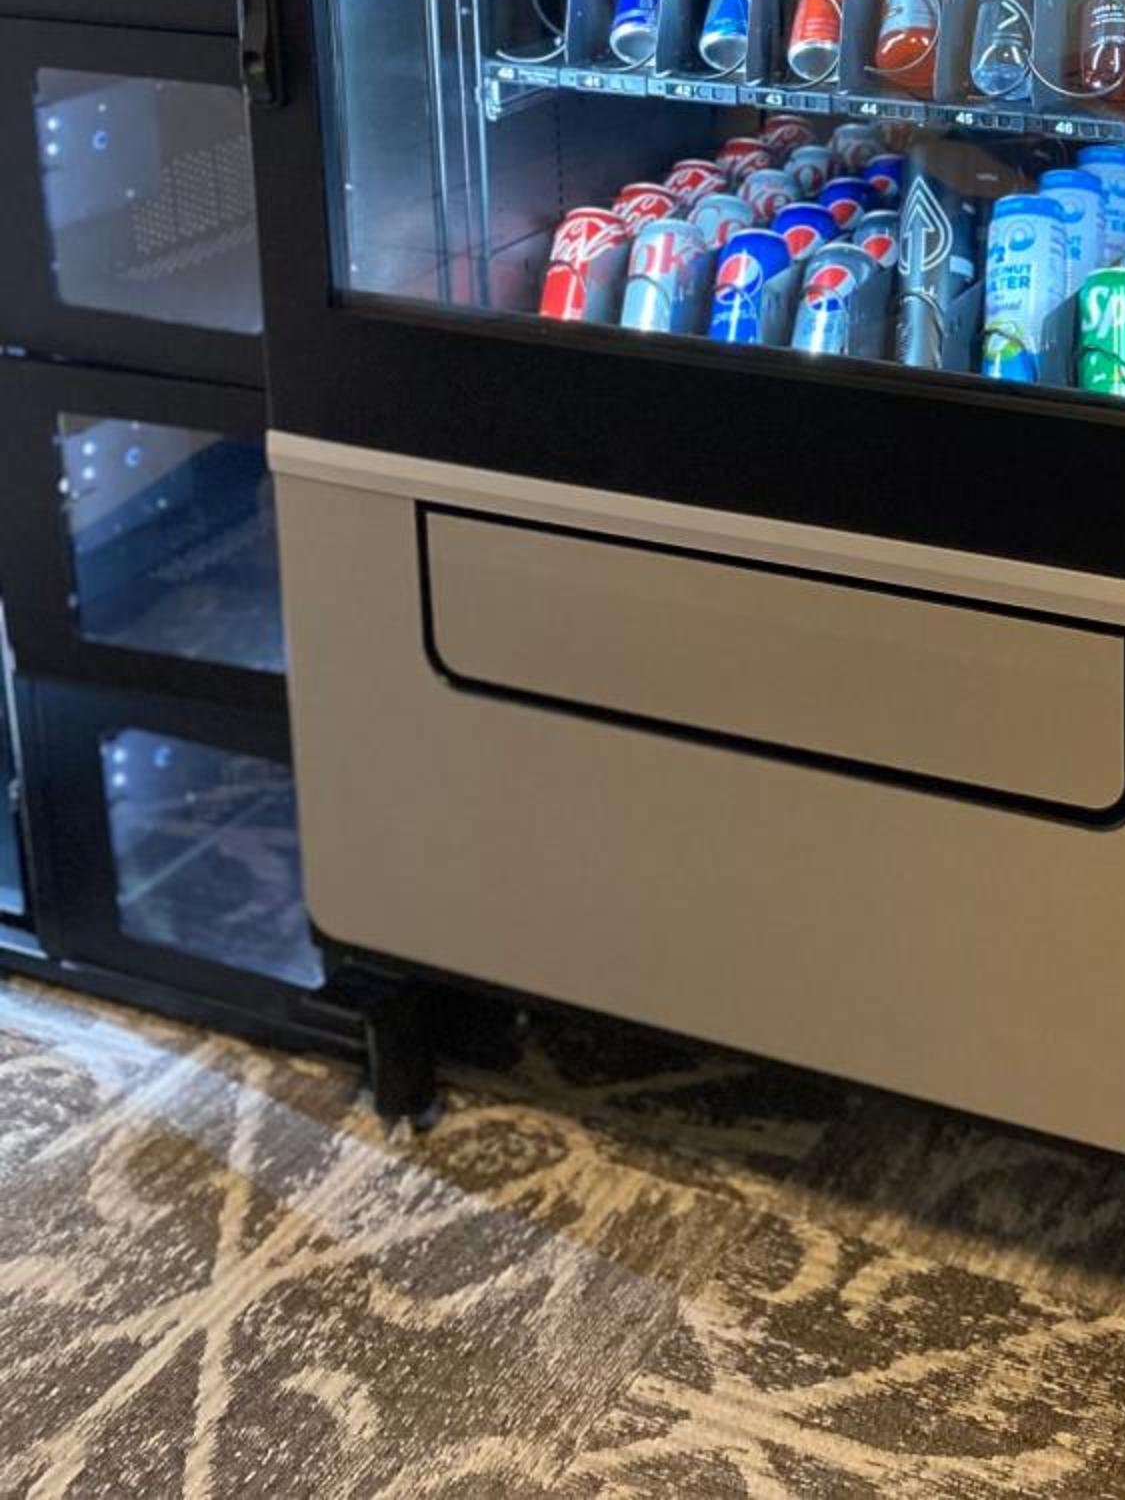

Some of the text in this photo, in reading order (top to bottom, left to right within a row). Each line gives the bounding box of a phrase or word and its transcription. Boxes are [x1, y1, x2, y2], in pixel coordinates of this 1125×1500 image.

[765, 93, 783, 107] 43
[860, 102, 878, 115] 44
[956, 112, 974, 125] 45
